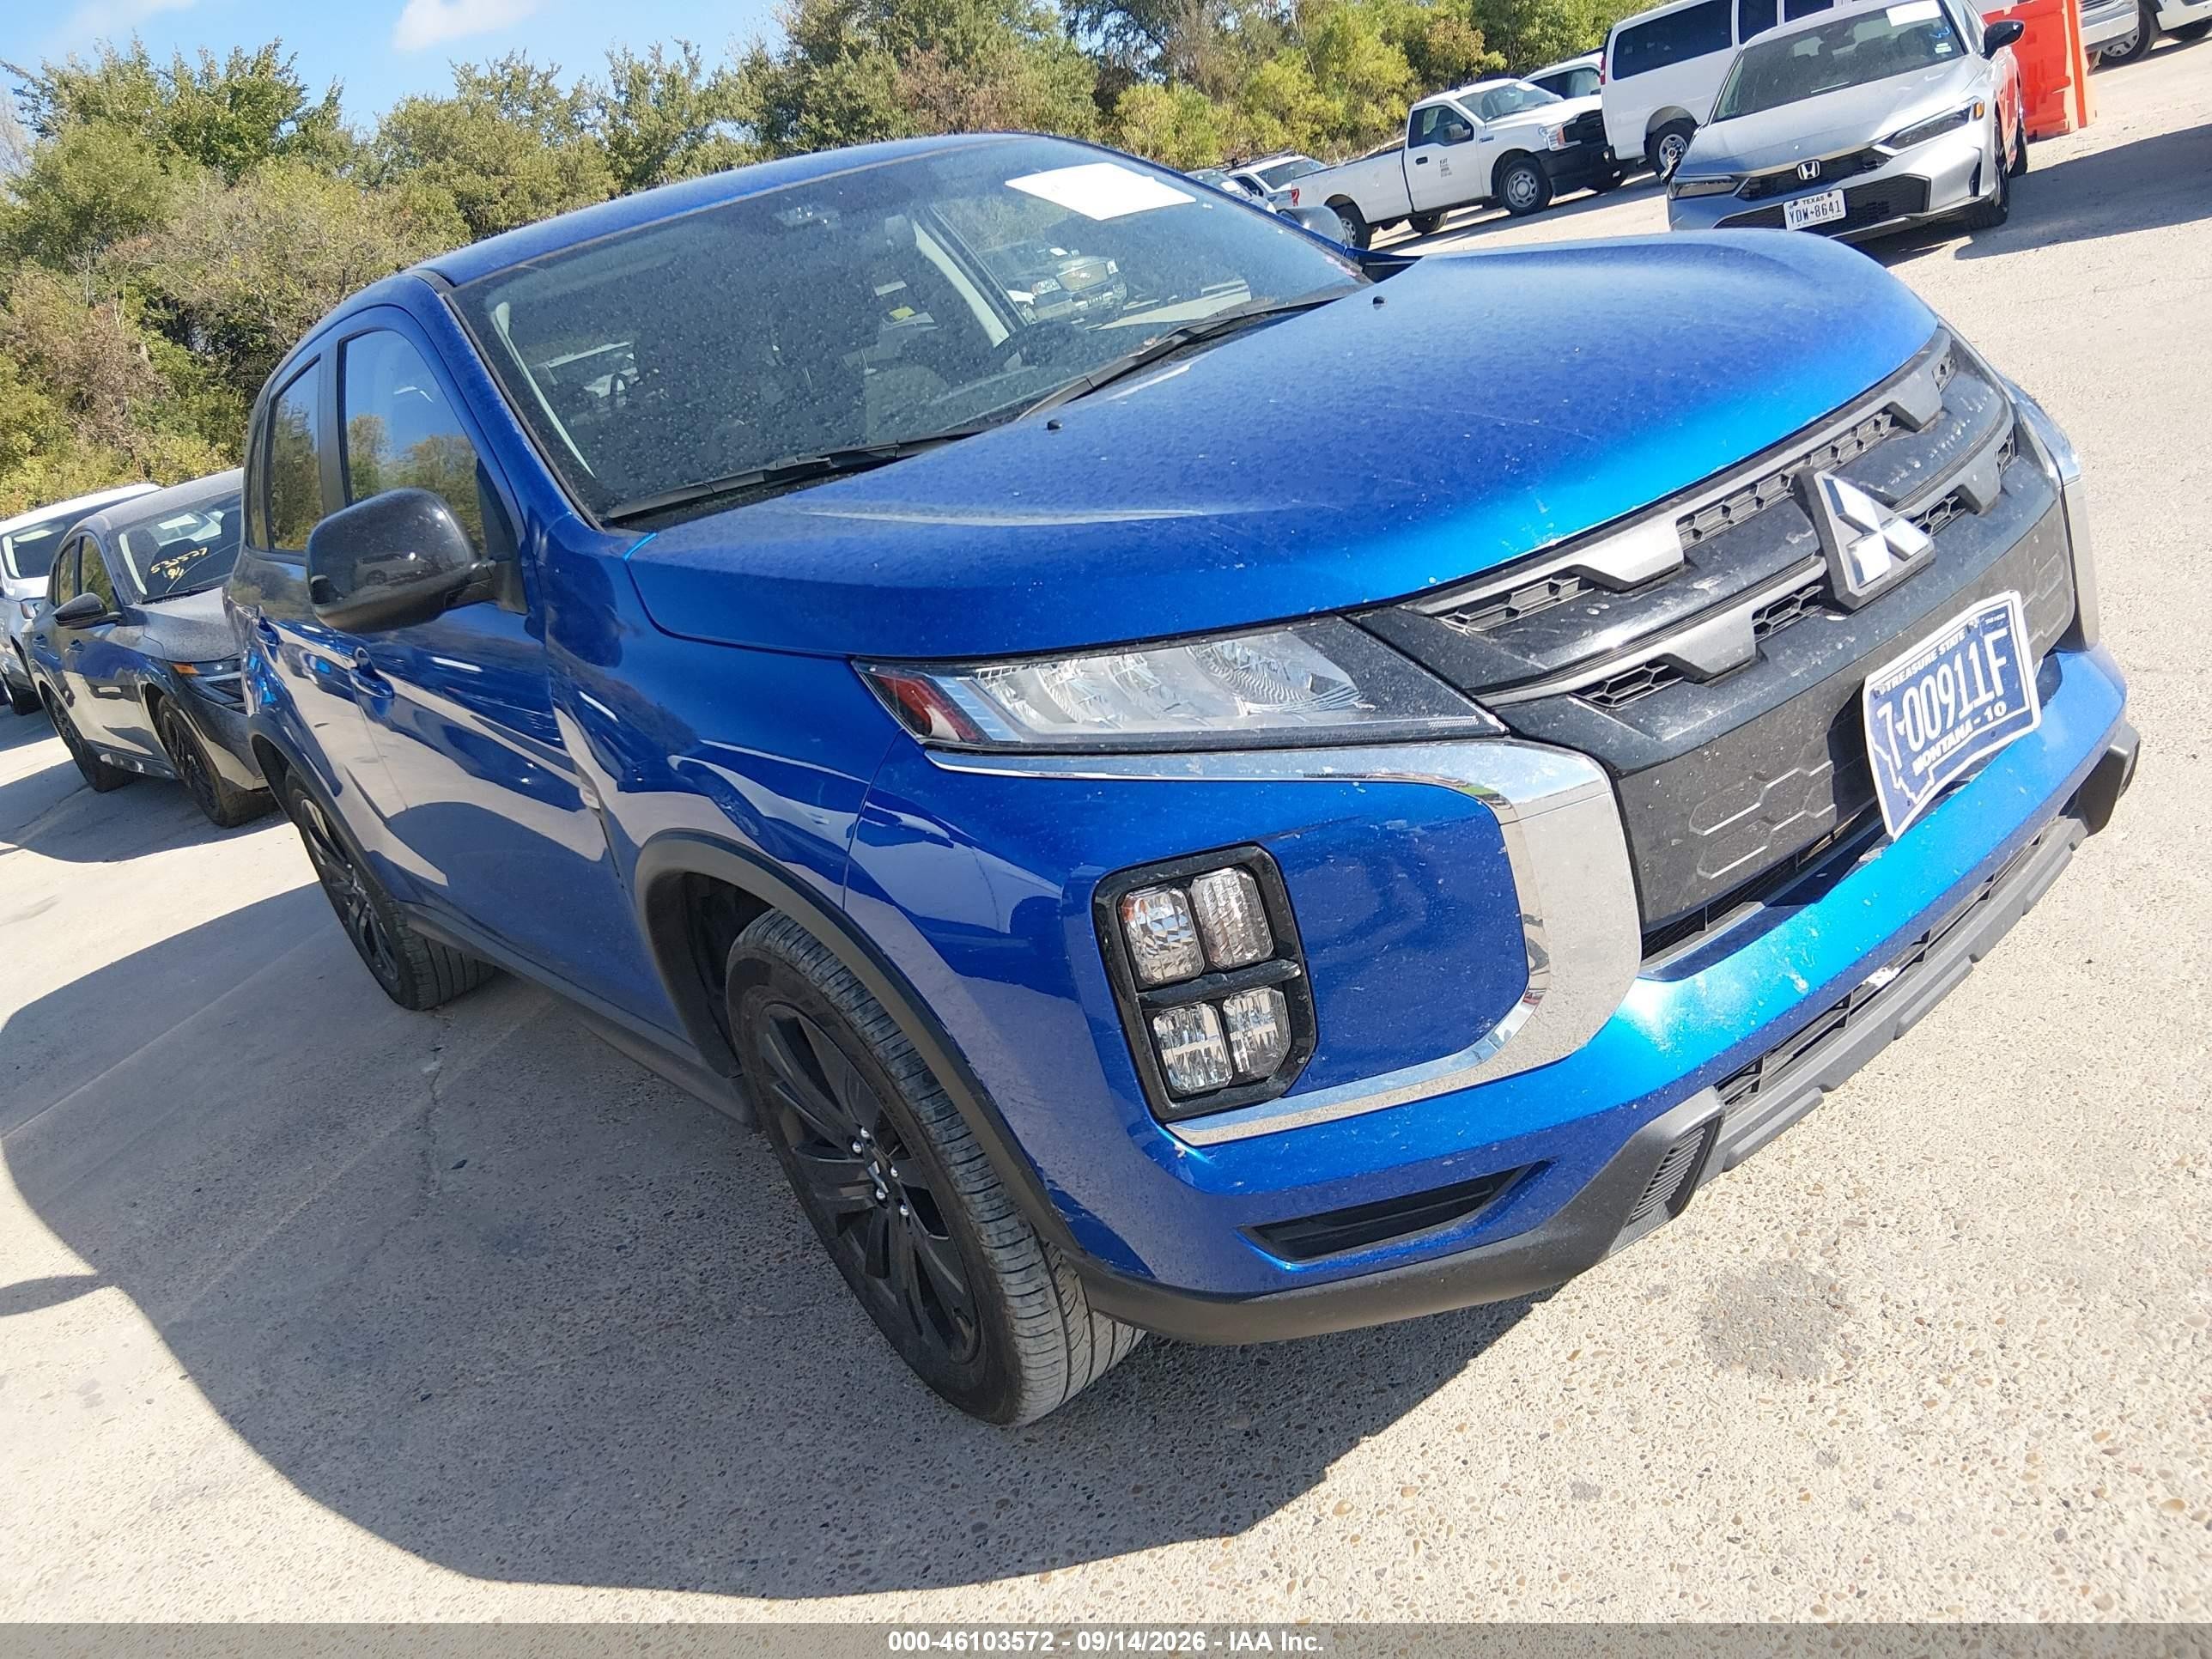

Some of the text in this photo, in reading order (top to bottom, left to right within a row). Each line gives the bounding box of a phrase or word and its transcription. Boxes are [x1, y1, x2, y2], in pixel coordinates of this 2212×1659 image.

[1802, 196, 1825, 205] TEXAS
[1887, 630, 1966, 690] TREASURE STATE
[1912, 719, 1973, 776] MONTANA
[1984, 700, 2007, 722] 10
